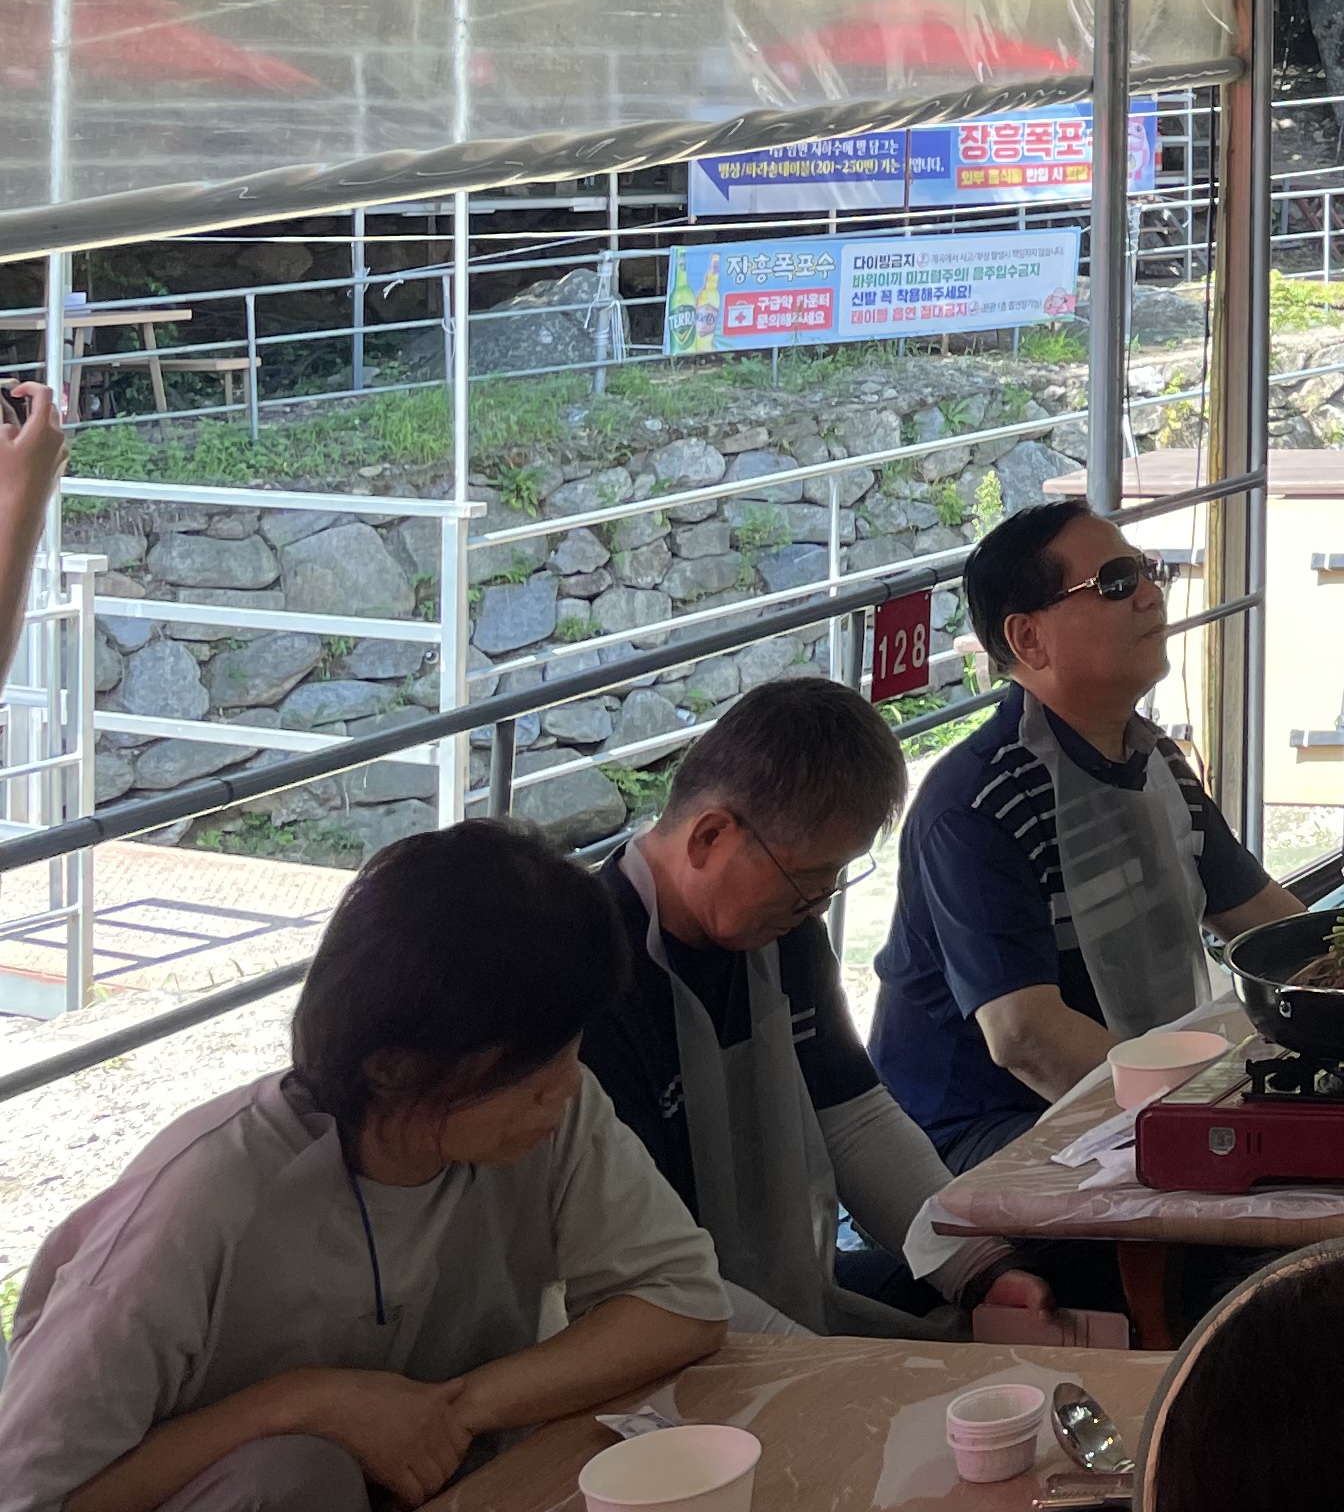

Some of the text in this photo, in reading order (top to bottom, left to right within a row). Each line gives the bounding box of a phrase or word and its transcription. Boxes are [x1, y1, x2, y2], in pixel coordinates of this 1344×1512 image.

[959, 121, 1093, 162] 장흥폭포
[904, 156, 944, 174] 입니다.
[1026, 166, 1049, 183] 반입
[1052, 166, 1063, 182] 시
[726, 251, 836, 285] 장흥폭포수
[853, 253, 915, 270] 다이빙금지
[852, 291, 877, 307] 신발
[669, 311, 695, 331] TERRA
[878, 623, 926, 679] 128
